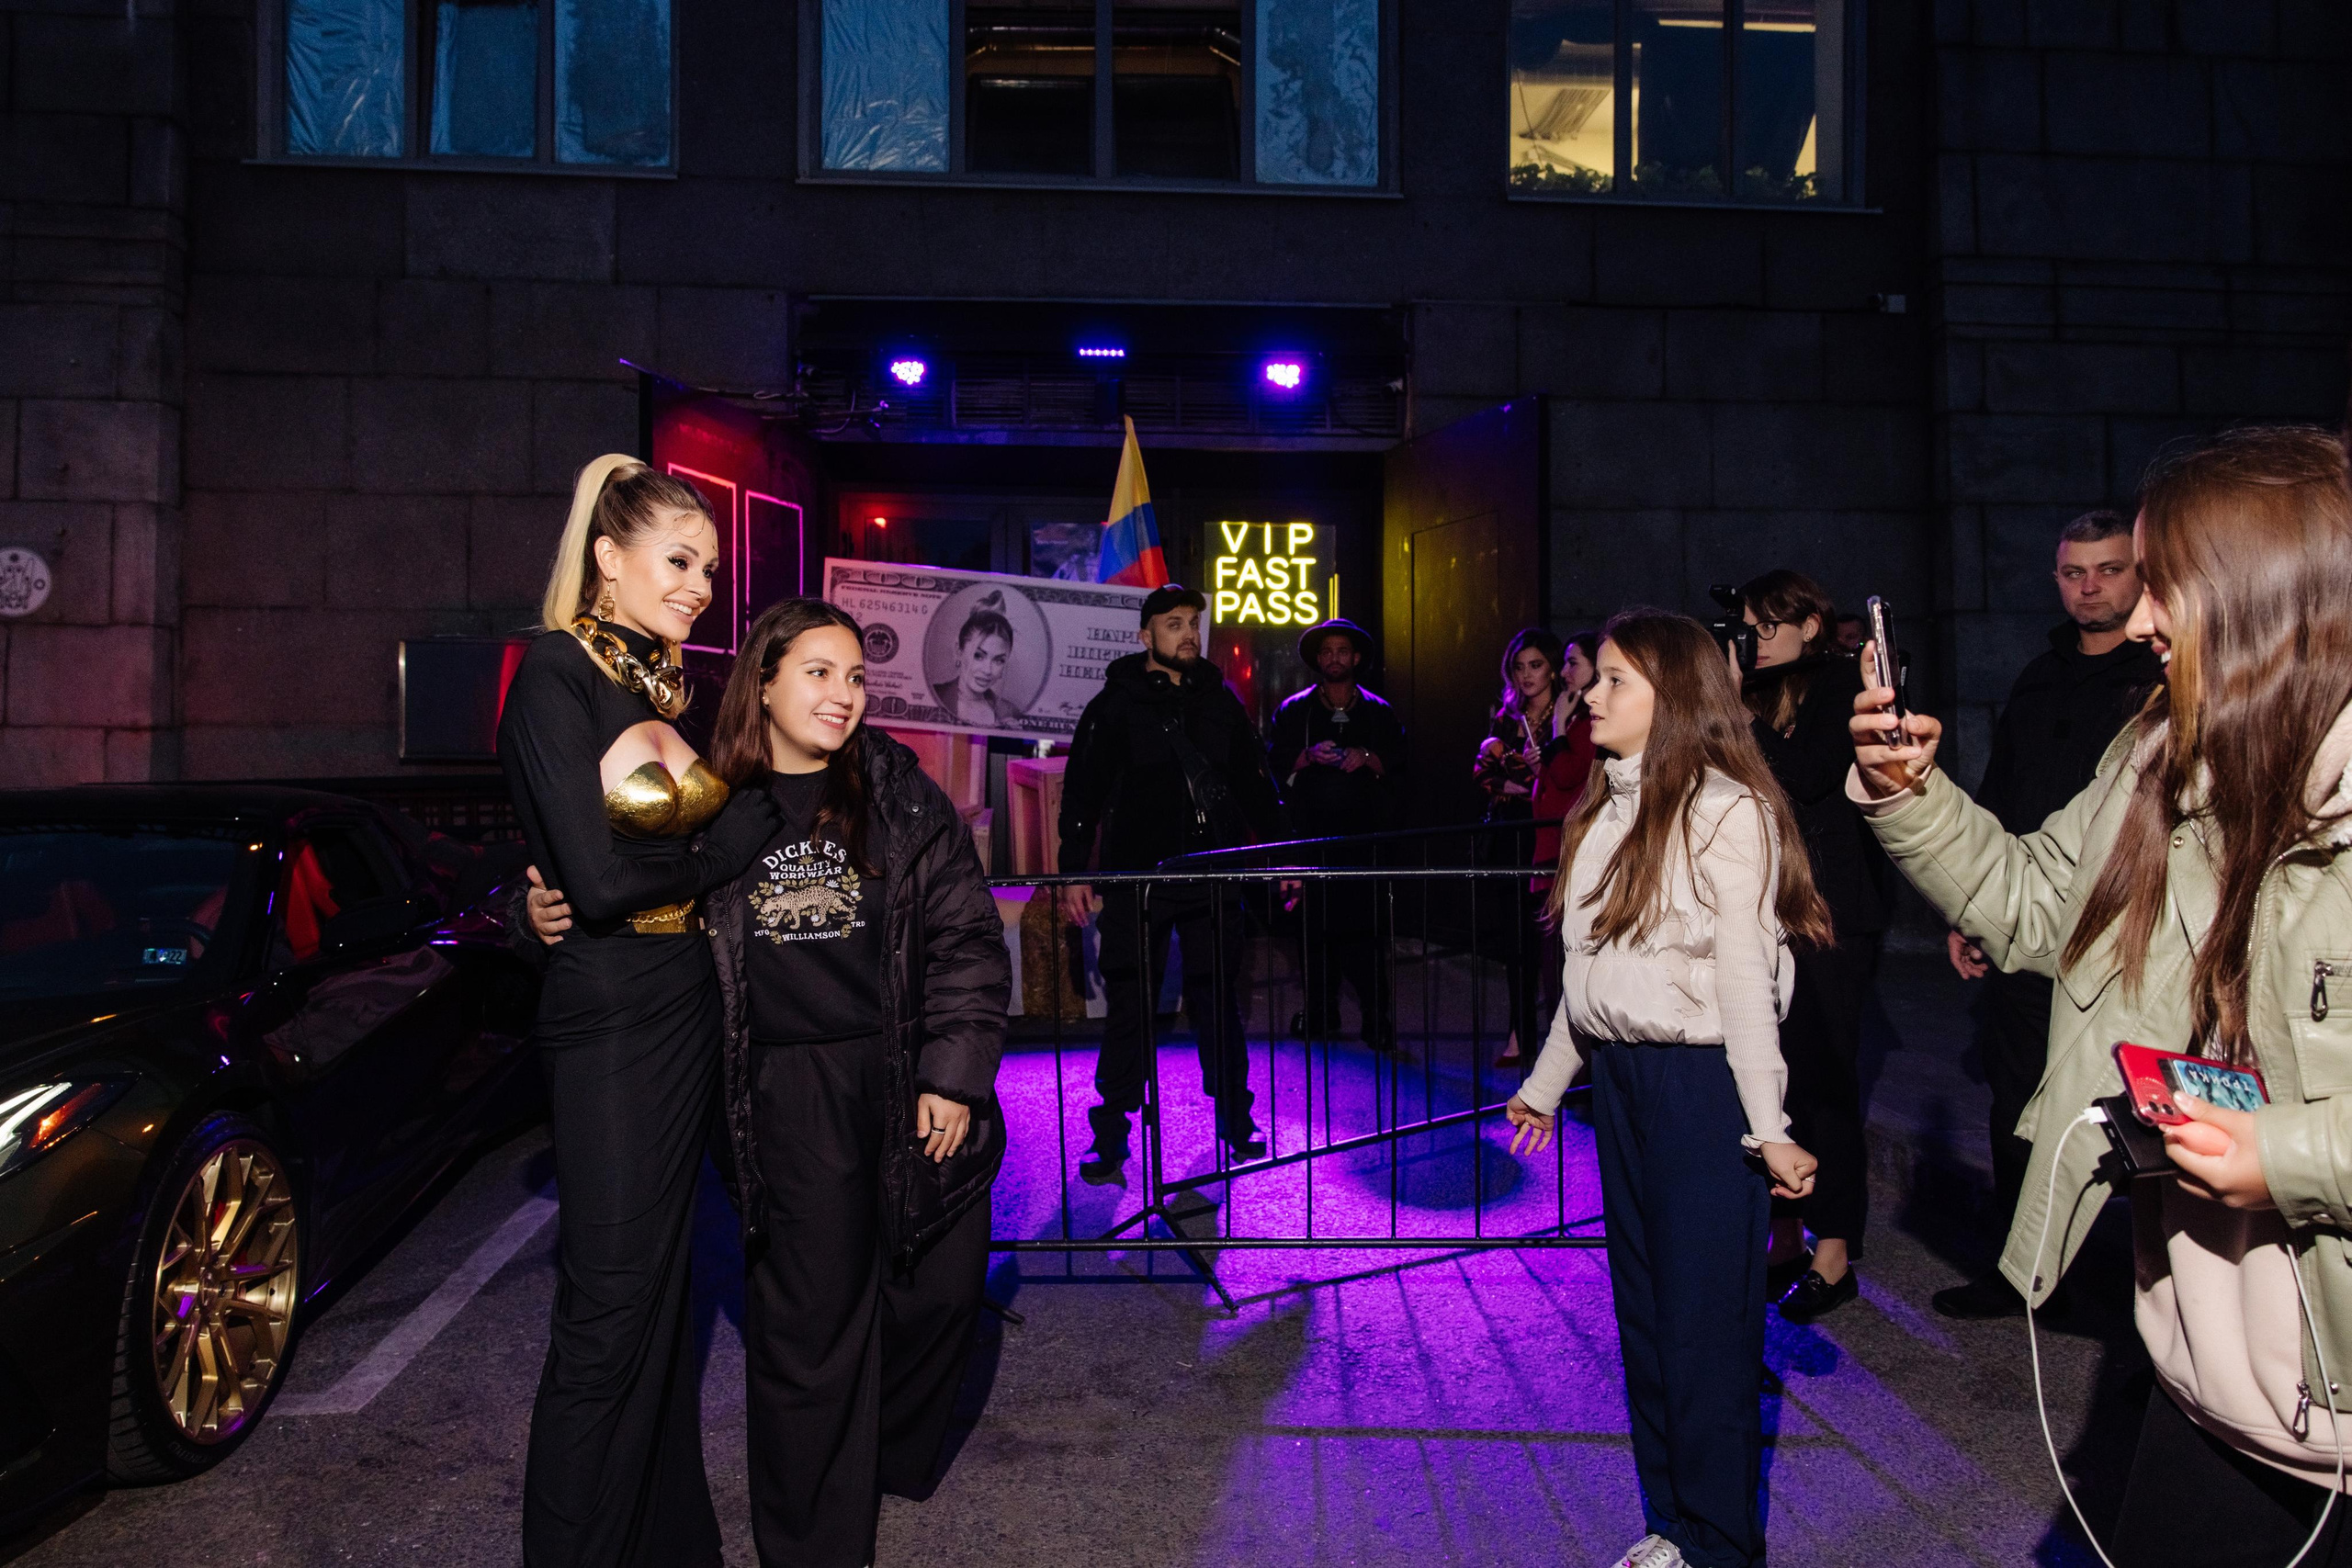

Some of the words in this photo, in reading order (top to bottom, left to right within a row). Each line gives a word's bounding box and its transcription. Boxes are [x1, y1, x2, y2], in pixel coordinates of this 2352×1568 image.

[1221, 521, 1314, 555] VIP
[1216, 556, 1317, 591] FAST
[1216, 591, 1319, 625] PASS
[763, 840, 847, 870] DICKES
[779, 860, 831, 873] QUALITY
[769, 865, 842, 880] WORKWEAR
[782, 930, 842, 942] WILLIAMSON
